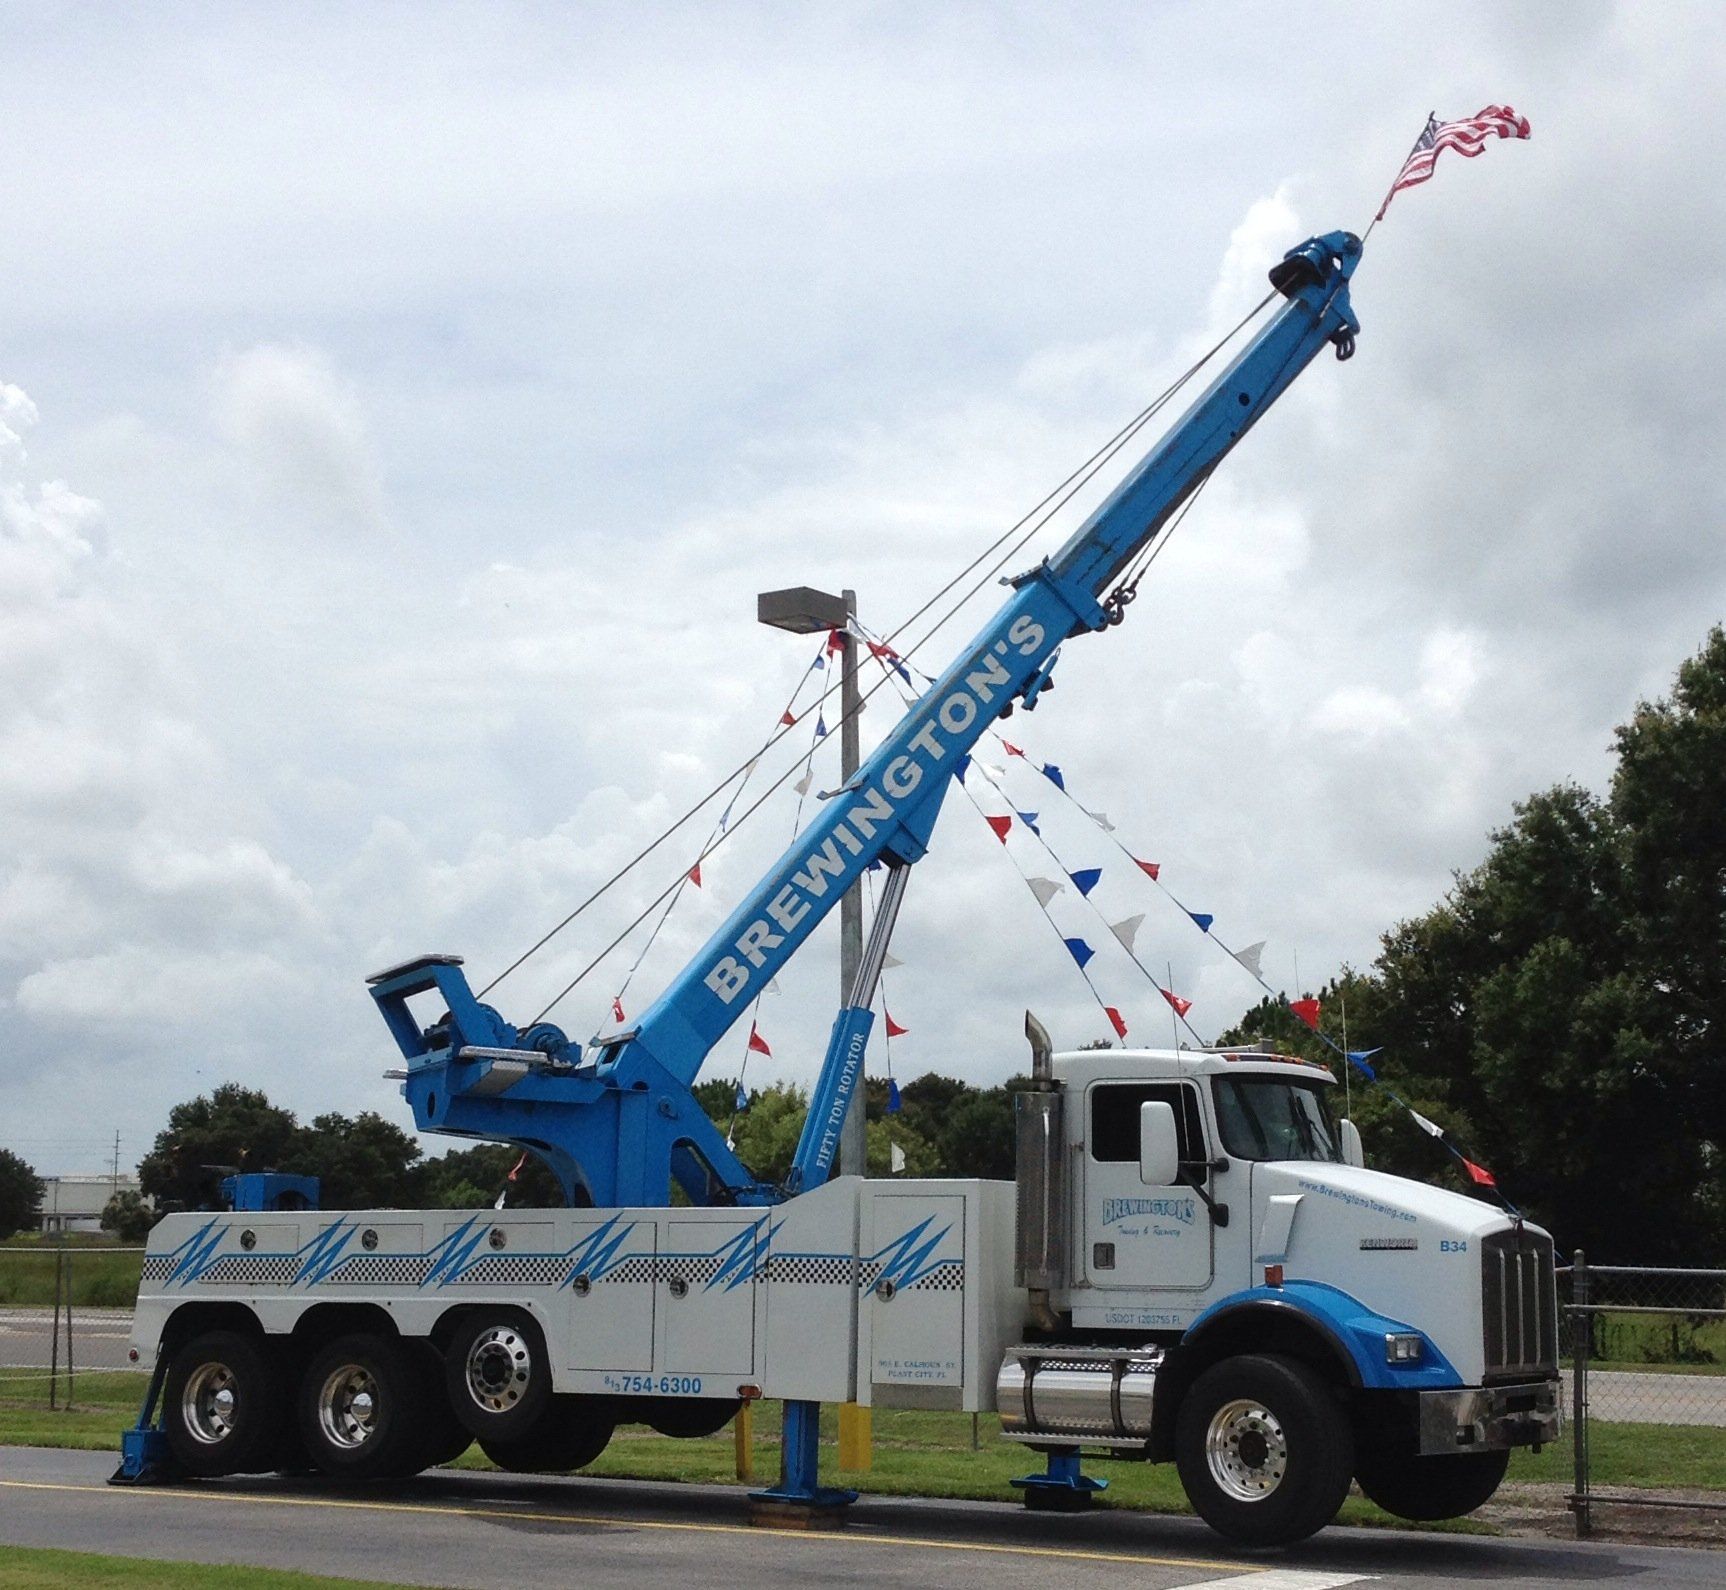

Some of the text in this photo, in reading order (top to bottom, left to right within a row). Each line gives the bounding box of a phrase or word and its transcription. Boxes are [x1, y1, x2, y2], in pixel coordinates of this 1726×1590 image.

[703, 614, 1046, 1005] BREWINGTON'S
[816, 1032, 865, 1168] FIFTY TON ROTATOR
[1440, 1240, 1467, 1252] B34
[1105, 1313, 1135, 1324] USDOT
[622, 1376, 702, 1394] 754-6300
